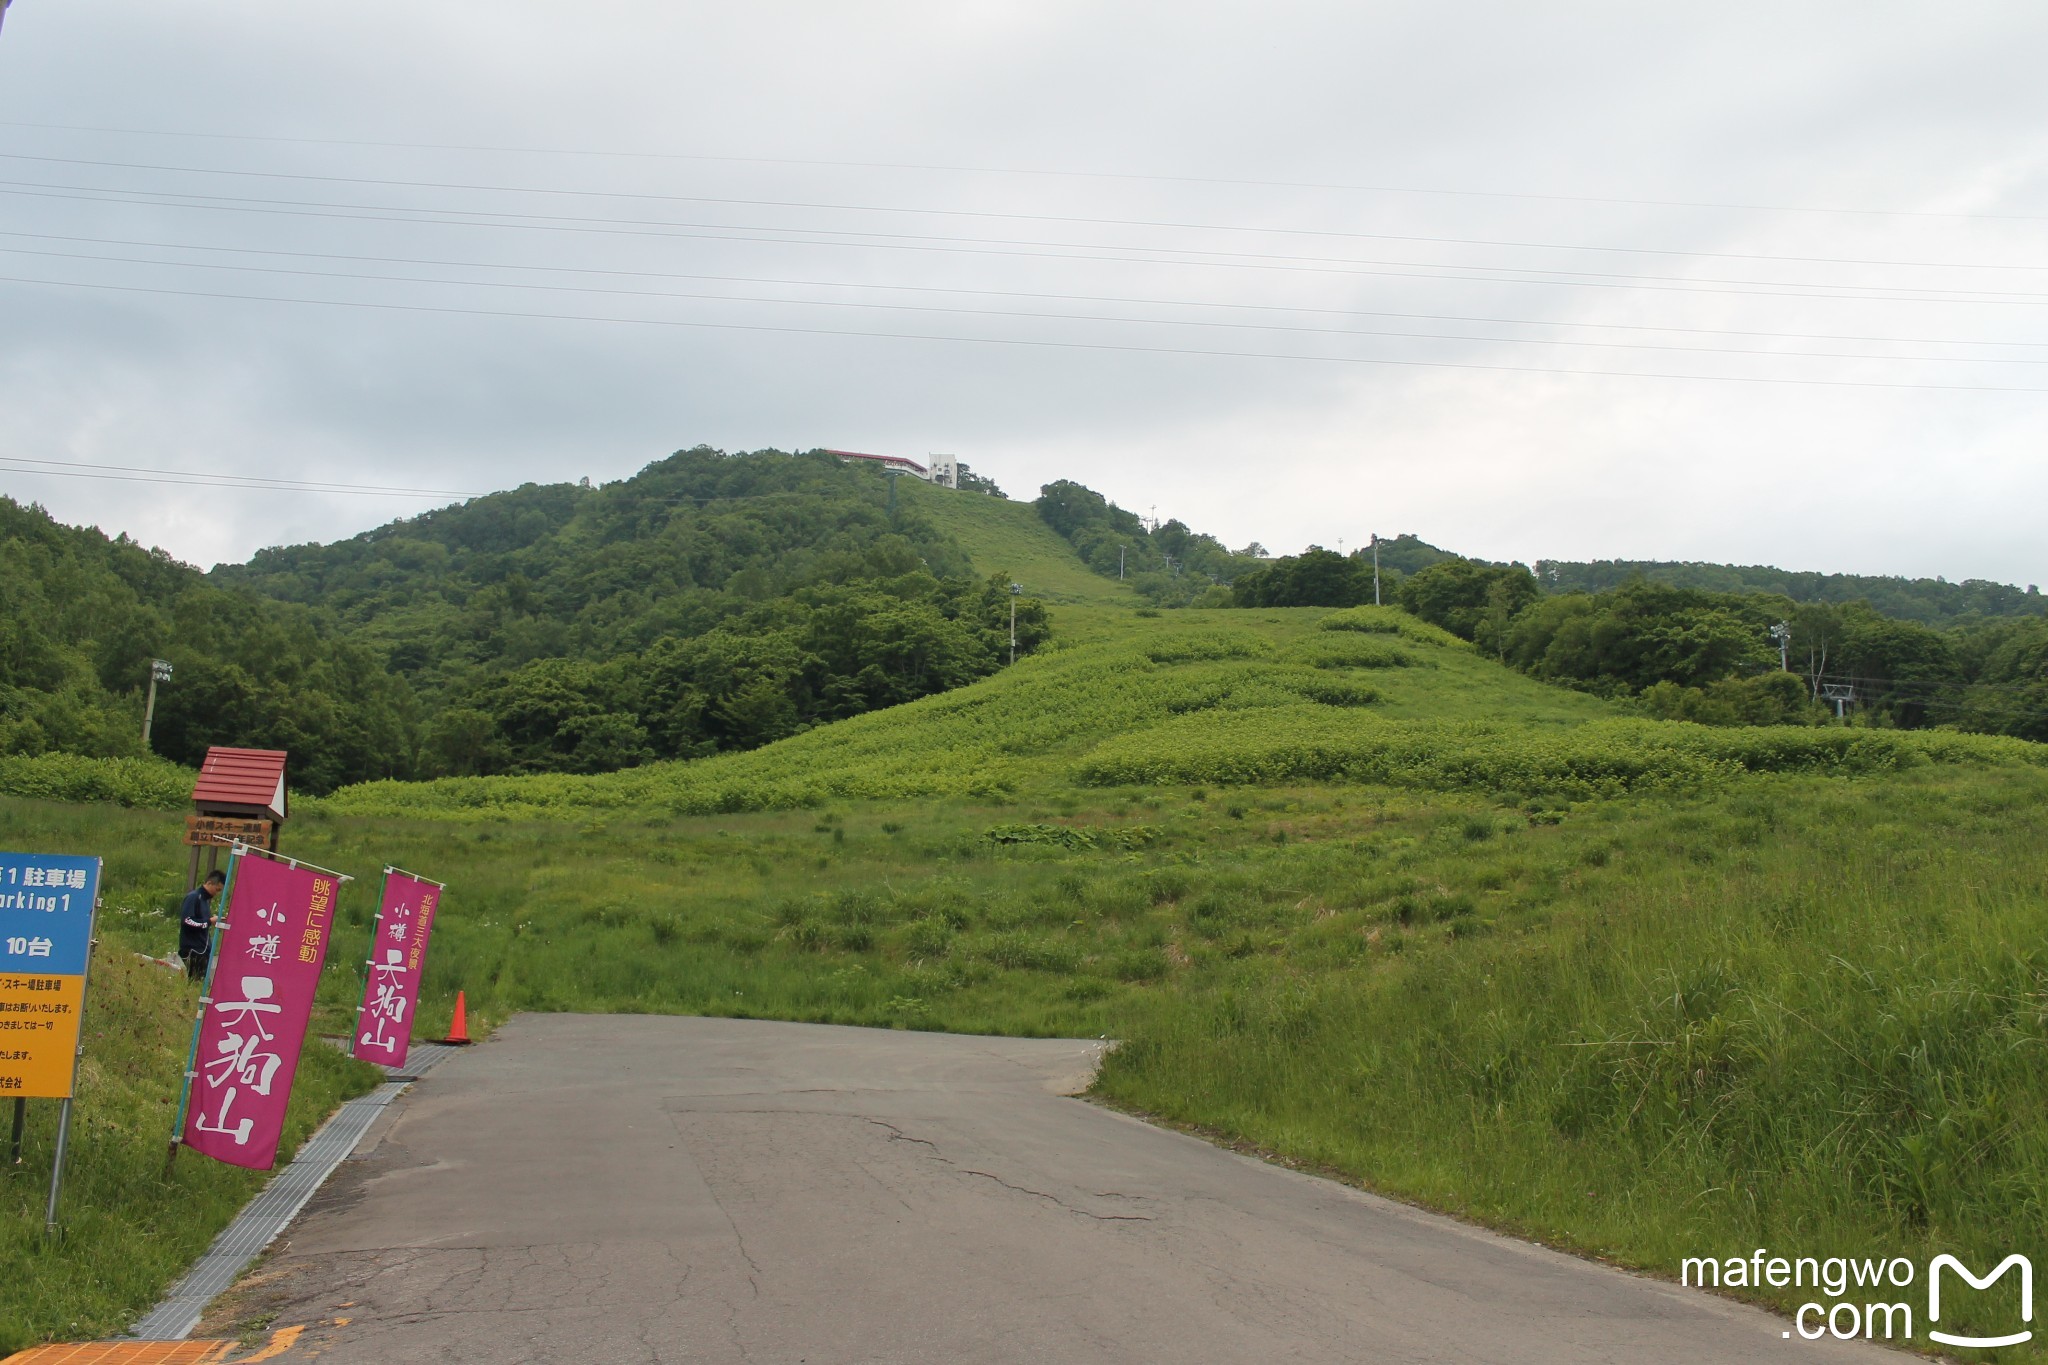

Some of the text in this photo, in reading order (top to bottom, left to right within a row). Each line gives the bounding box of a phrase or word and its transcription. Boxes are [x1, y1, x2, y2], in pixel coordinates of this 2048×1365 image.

[0, 867, 87, 889] 1駐車場
[62, 893, 70, 911] 1
[297, 878, 331, 964] 眺望に感動
[7, 936, 53, 957] 10台
